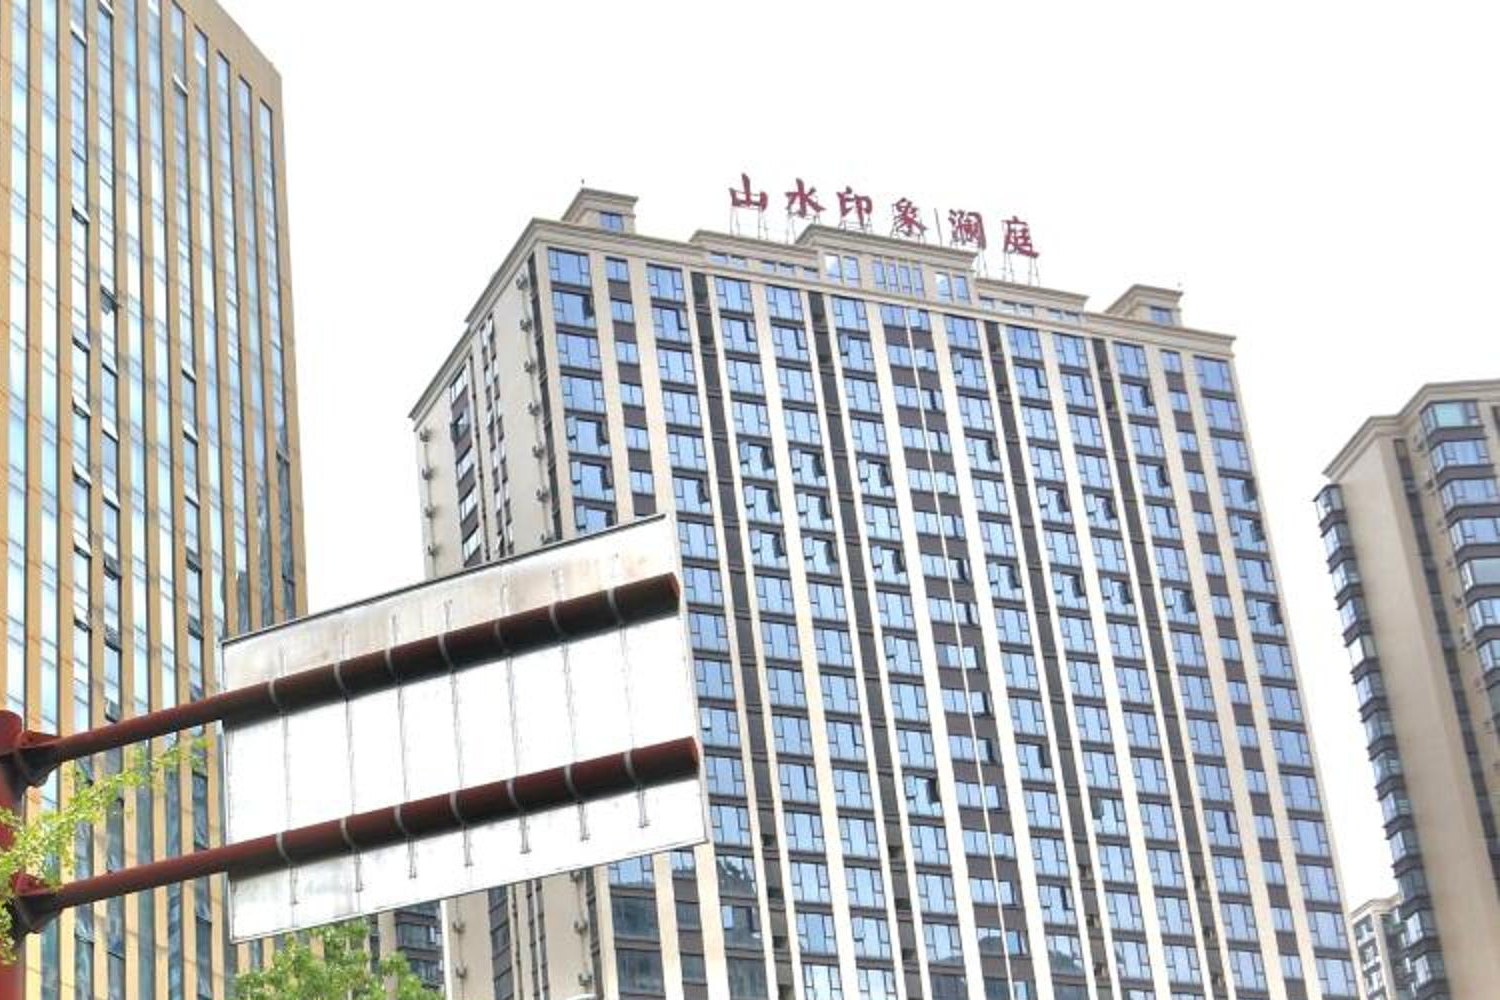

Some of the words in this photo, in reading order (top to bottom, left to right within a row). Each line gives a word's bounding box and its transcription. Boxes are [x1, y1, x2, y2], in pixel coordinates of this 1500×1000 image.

[728, 172, 1040, 258] 山水印象澜庭
